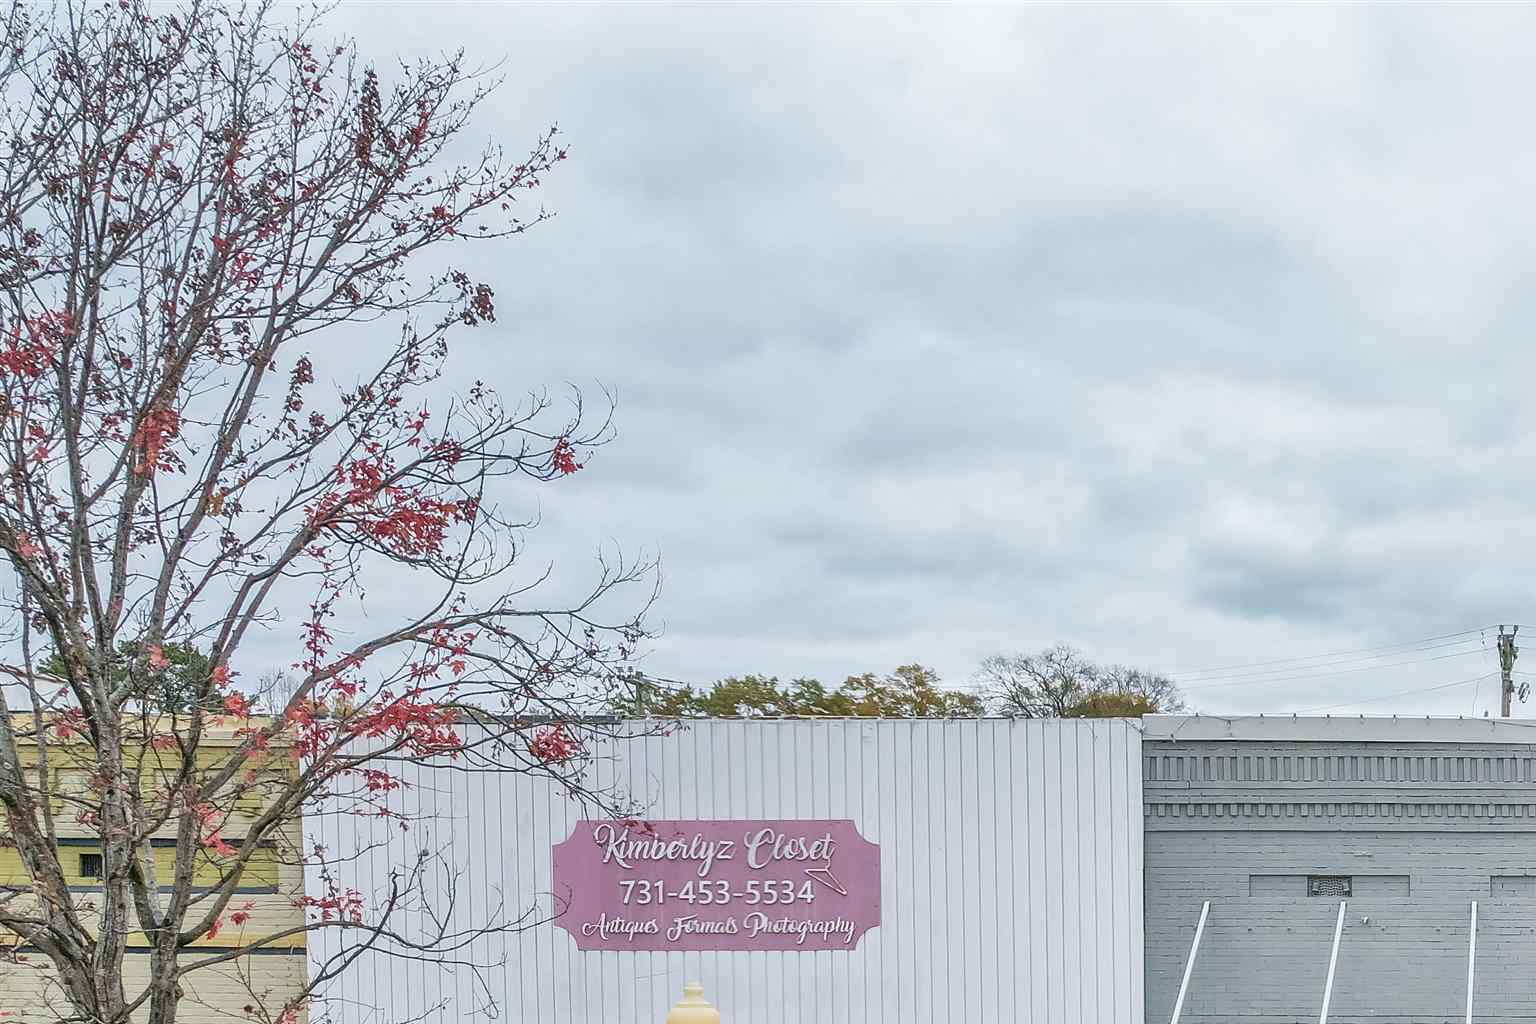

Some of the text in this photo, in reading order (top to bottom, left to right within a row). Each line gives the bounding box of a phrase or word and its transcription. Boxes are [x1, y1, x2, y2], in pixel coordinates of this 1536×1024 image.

[593, 824, 840, 877] Kimberlyz Closet
[620, 880, 815, 905] 731-453-5534
[582, 912, 856, 944] Antiques Formals Photography
